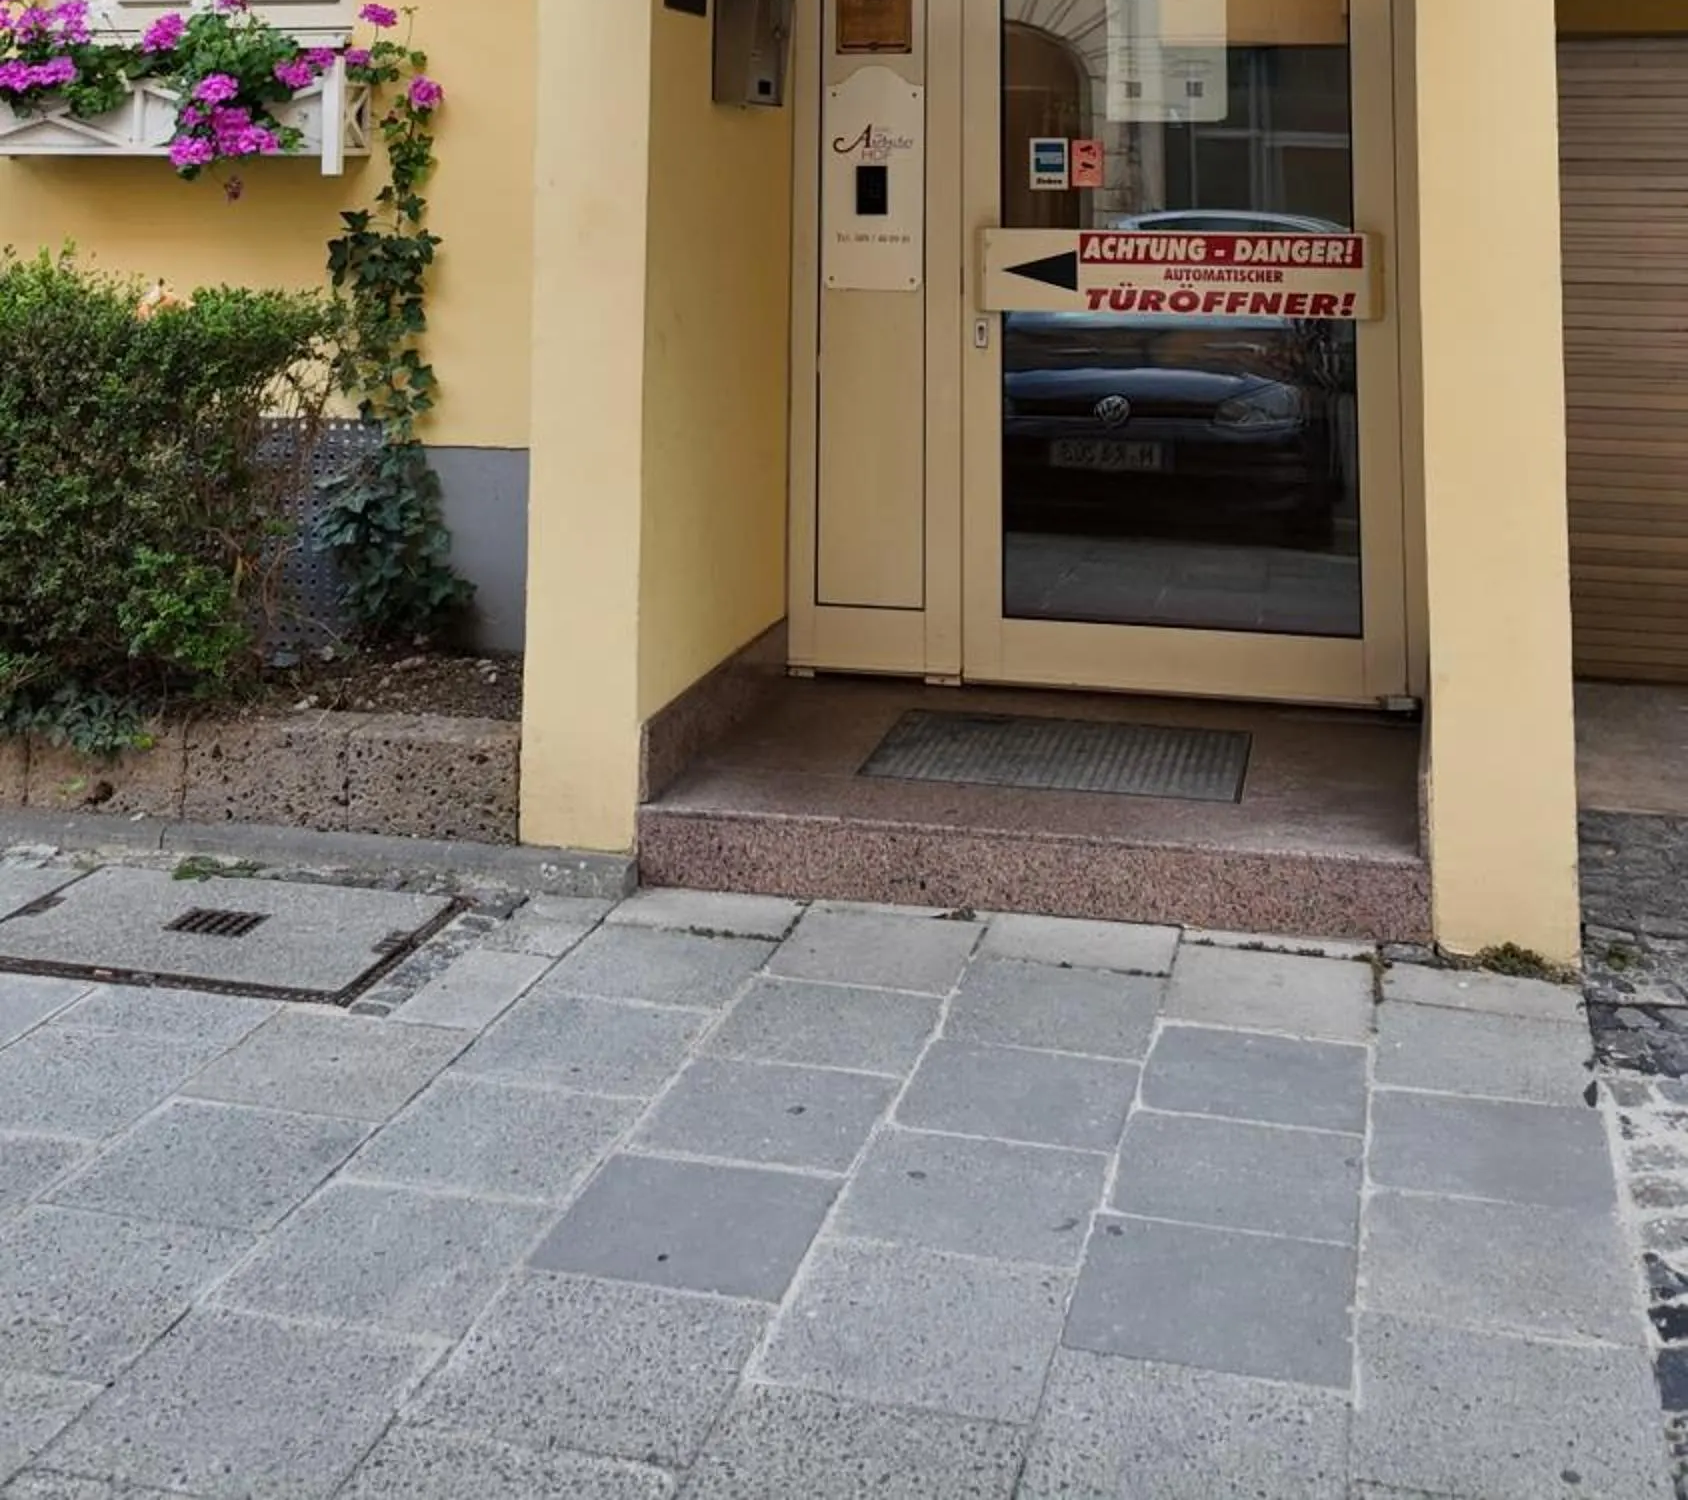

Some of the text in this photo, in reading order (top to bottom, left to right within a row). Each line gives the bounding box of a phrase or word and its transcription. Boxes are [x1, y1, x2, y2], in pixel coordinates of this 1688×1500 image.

[1083, 237, 1207, 261] ACHTUNG
[1233, 239, 1354, 263] DANGER!
[1163, 268, 1284, 284] AUTOMATISCHER
[1085, 283, 1357, 316] TÜRÖFFNER!
